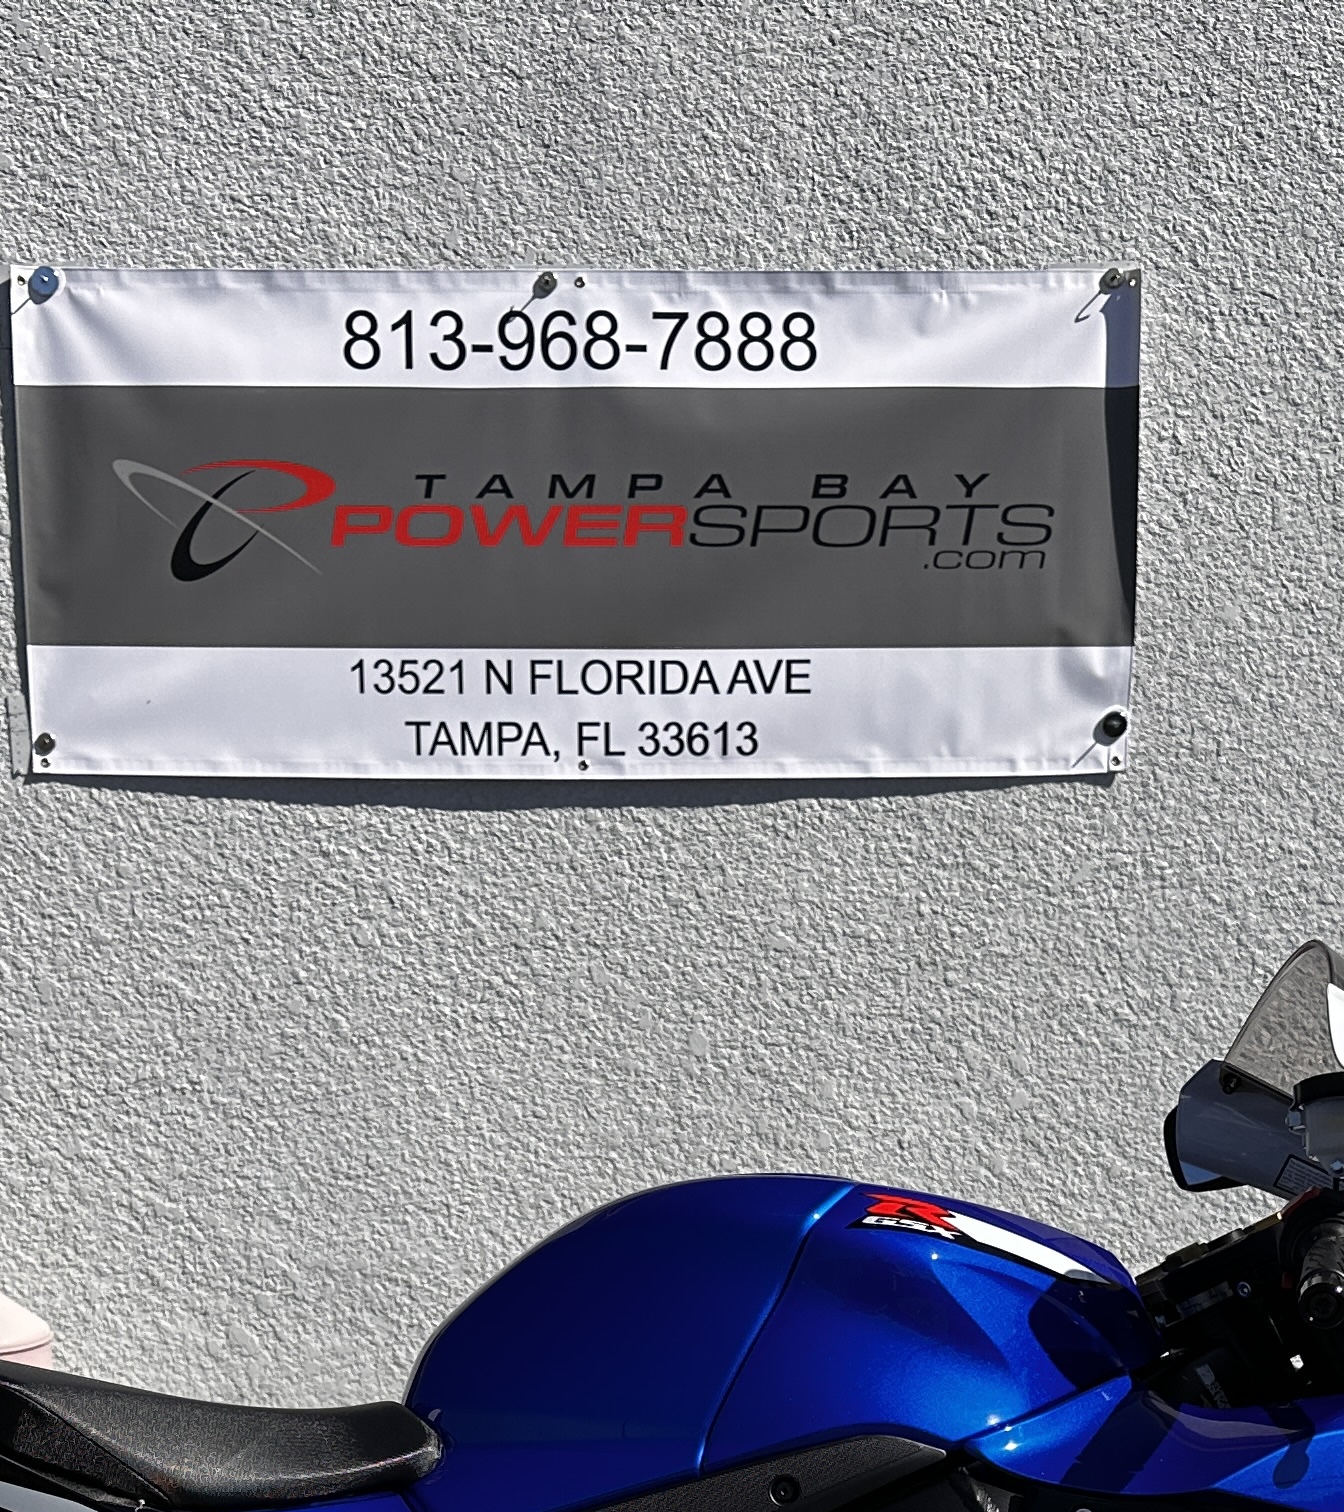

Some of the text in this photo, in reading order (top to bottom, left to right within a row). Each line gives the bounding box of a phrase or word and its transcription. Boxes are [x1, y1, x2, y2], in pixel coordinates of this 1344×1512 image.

[343, 309, 819, 373] 813-968-7888
[415, 472, 992, 500] TAMPA BAY
[328, 502, 1057, 549] POWERSPORTS
[923, 544, 1048, 572] .com
[351, 659, 813, 697] 13521 N FLORIDA AVE
[404, 722, 760, 766] TAMPA, FL 33613
[861, 1214, 956, 1240] GSX
